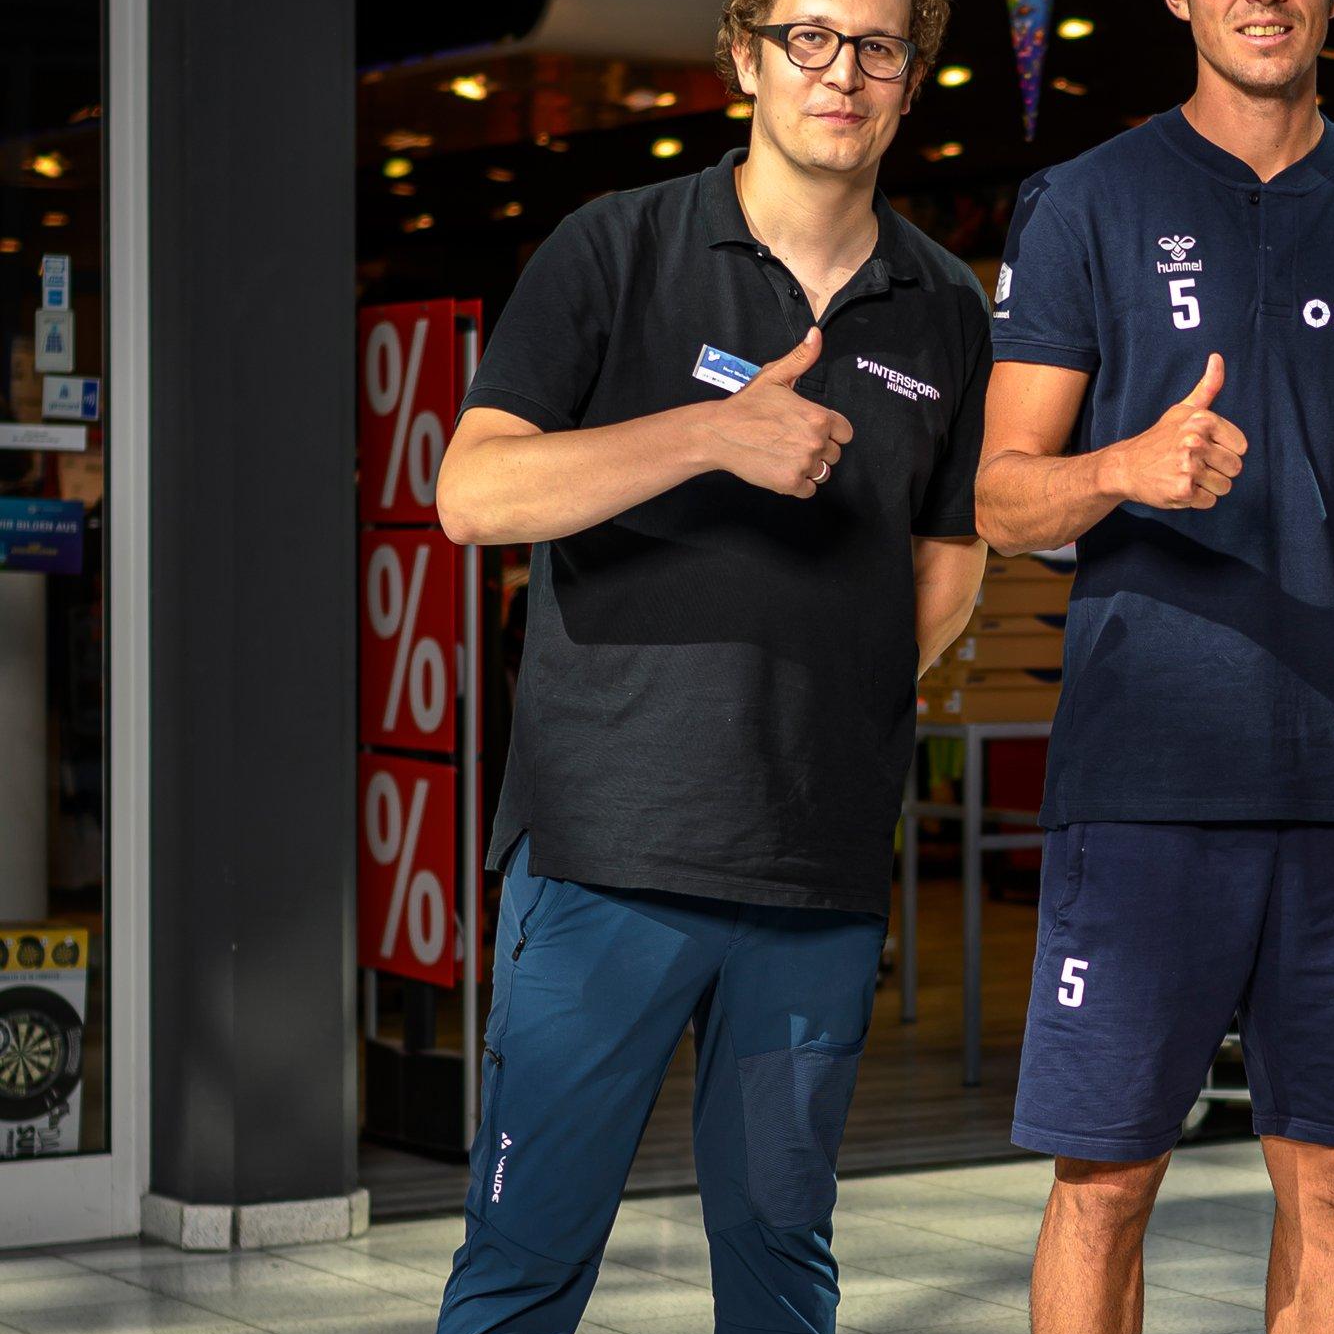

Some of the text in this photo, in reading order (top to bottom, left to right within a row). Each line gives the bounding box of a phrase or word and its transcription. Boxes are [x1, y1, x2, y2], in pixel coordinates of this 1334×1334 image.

[1157, 259, 1203, 274] hummel
[1168, 278, 1201, 330] 5
[868, 361, 941, 400] INTERSPORT
[1057, 957, 1089, 1008] 5
[491, 1155, 507, 1204] VAUDE
